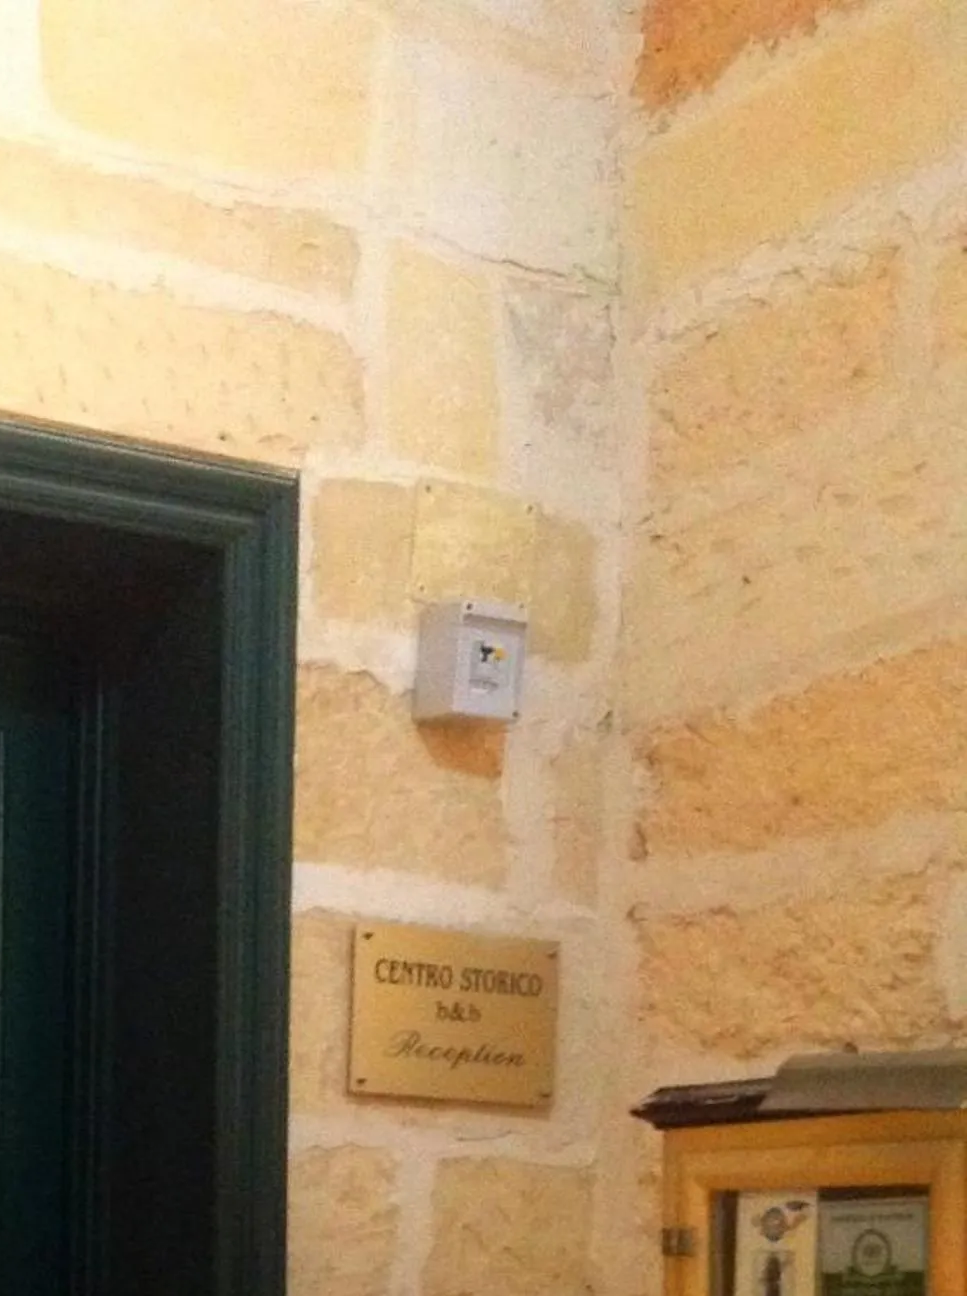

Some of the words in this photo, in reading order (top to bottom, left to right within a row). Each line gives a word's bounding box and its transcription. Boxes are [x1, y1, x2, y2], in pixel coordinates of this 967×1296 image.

[374, 958, 453, 990] CENTRO
[459, 967, 544, 998] STORICO
[435, 1000, 482, 1023] b&b
[385, 1029, 527, 1069] Reception
